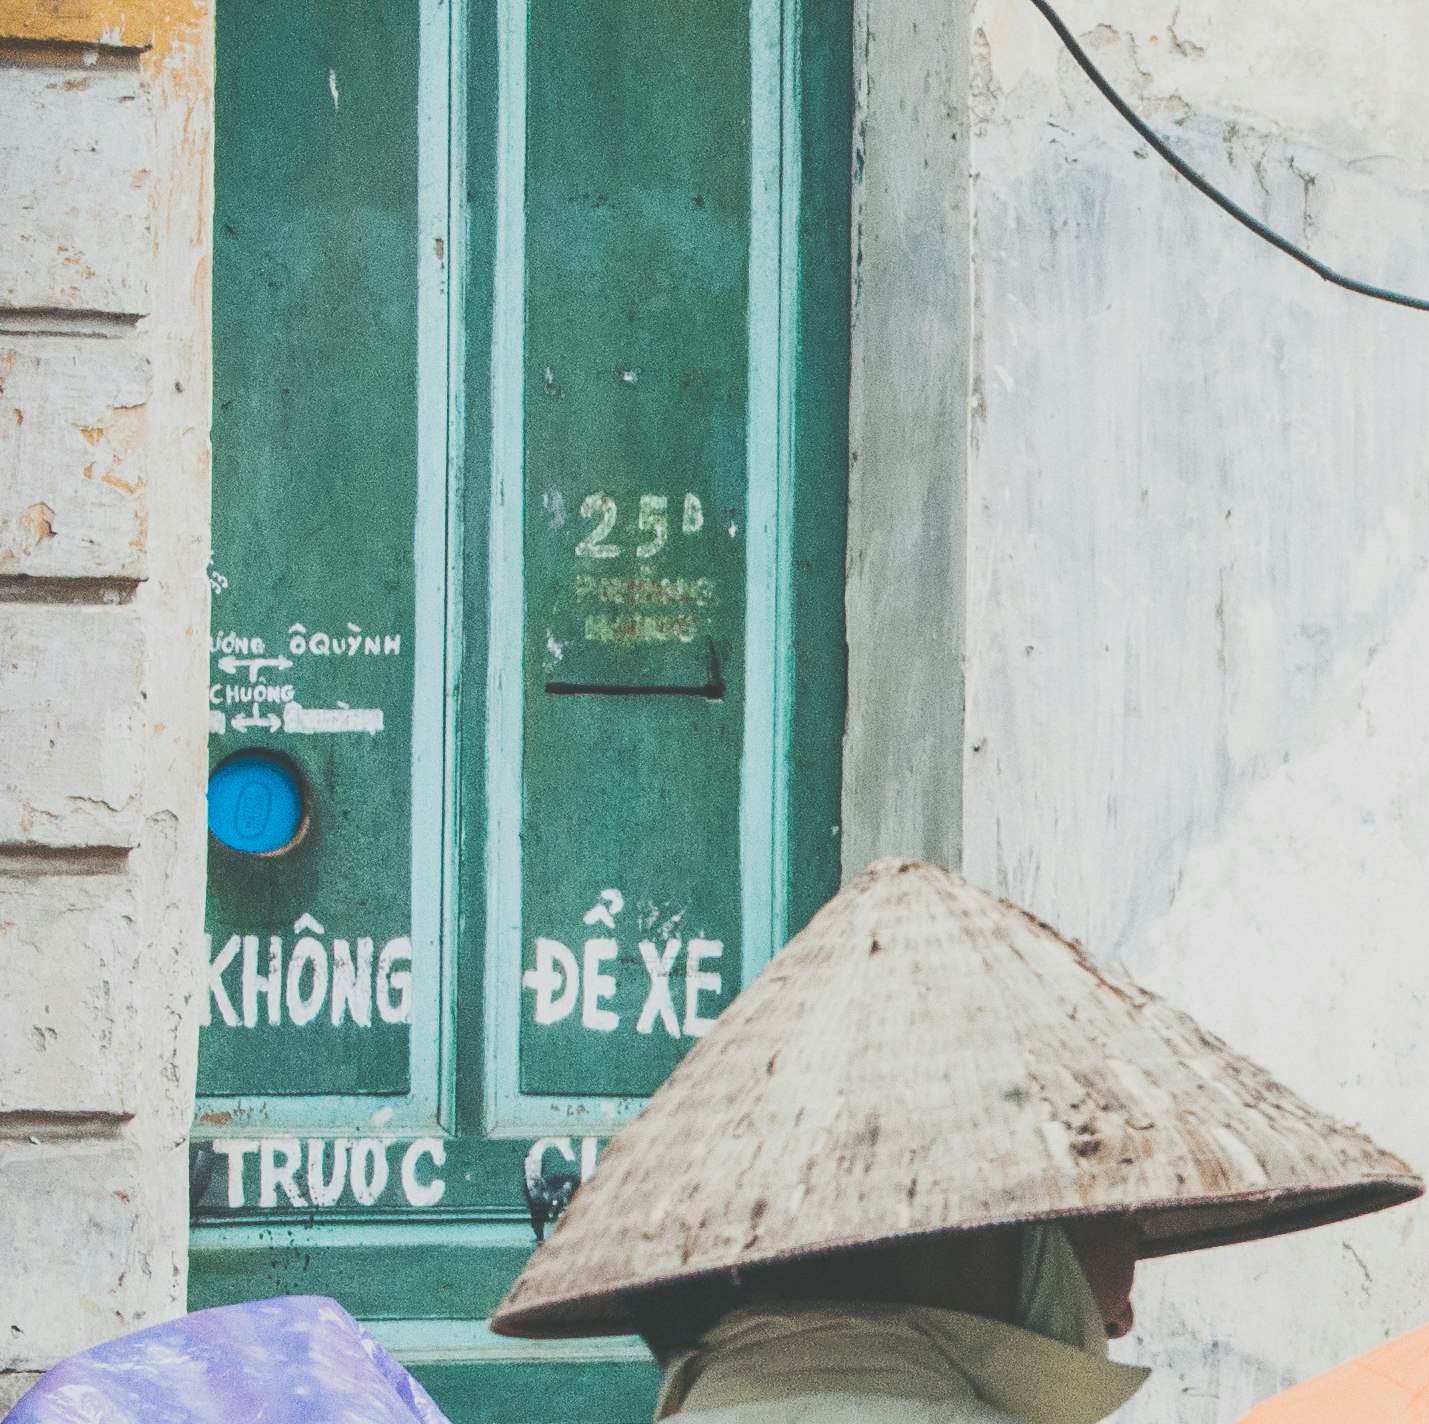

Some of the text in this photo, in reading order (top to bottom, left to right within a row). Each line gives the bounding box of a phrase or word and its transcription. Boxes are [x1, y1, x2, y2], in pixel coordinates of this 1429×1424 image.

[199, 888, 724, 1039] KHÔNG ĐỂ XE
